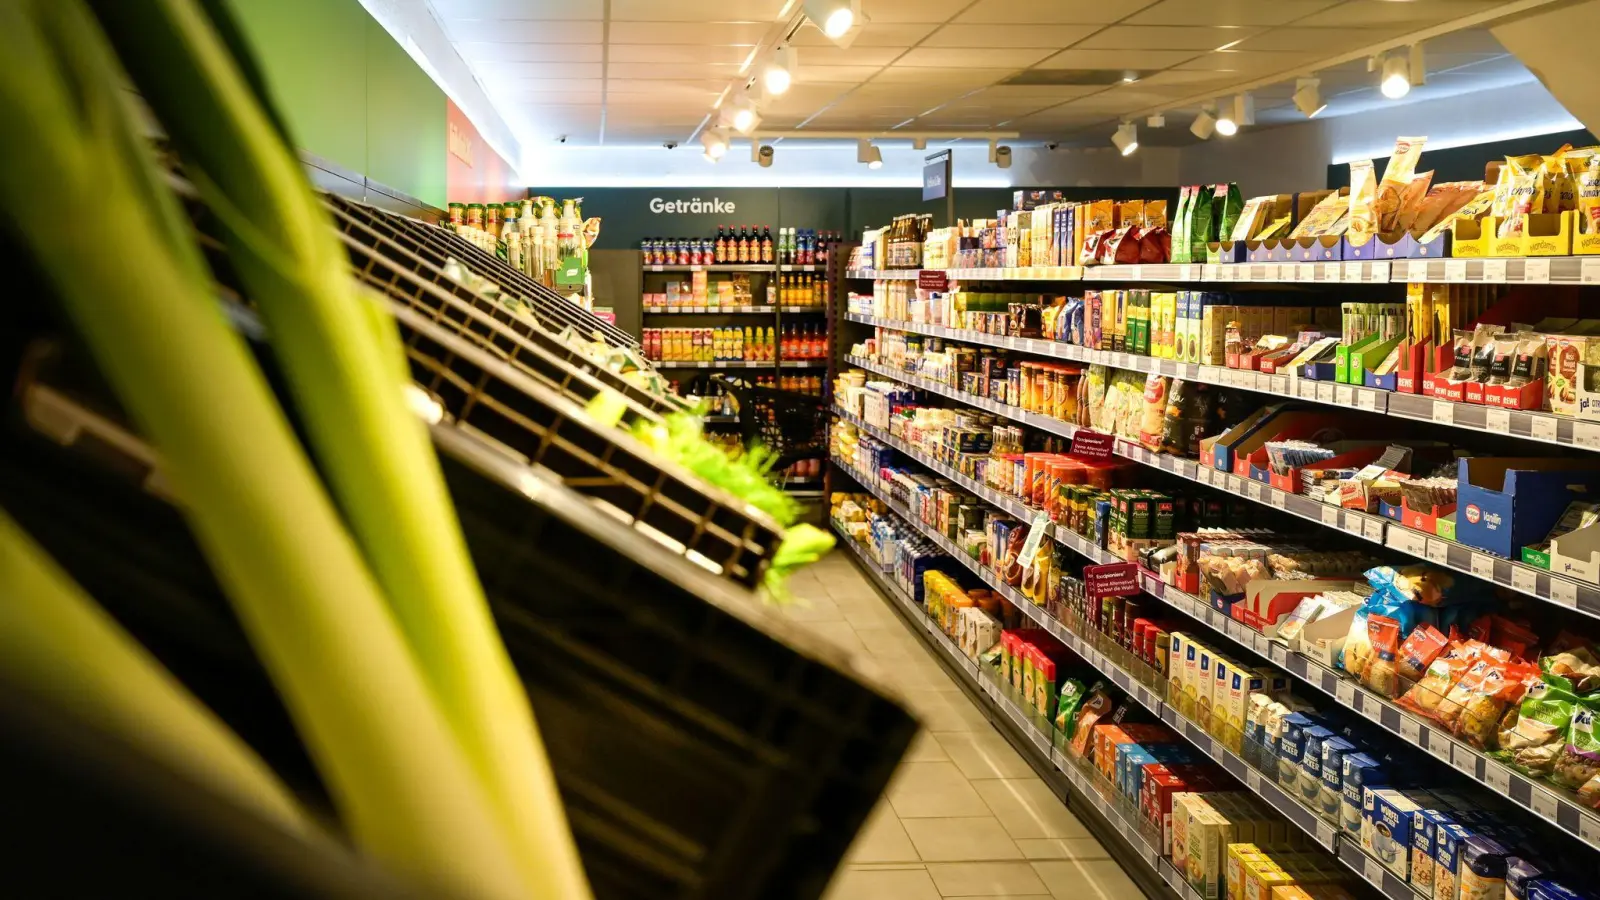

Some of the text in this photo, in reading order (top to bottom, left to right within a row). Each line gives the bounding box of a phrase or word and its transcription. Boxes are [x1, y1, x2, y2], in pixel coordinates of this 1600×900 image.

[649, 197, 736, 214] Getränke
[1457, 242, 1481, 254] Mondamin
[1496, 242, 1520, 254] Mondamin
[1529, 240, 1557, 253] Mondamin
[1398, 378, 1413, 388] REWE
[1447, 389, 1461, 399] REWE
[1467, 391, 1482, 401] REWE
[1486, 393, 1501, 404] REWE
[1503, 396, 1518, 406] REWE
[1580, 397, 1590, 413] ja!
[1483, 510, 1502, 525] Vanillin
[1365, 793, 1373, 810] ja!
[1381, 803, 1400, 824] WÜRFEL
[1415, 813, 1424, 827] ja!
[1415, 832, 1430, 847] PUDER
